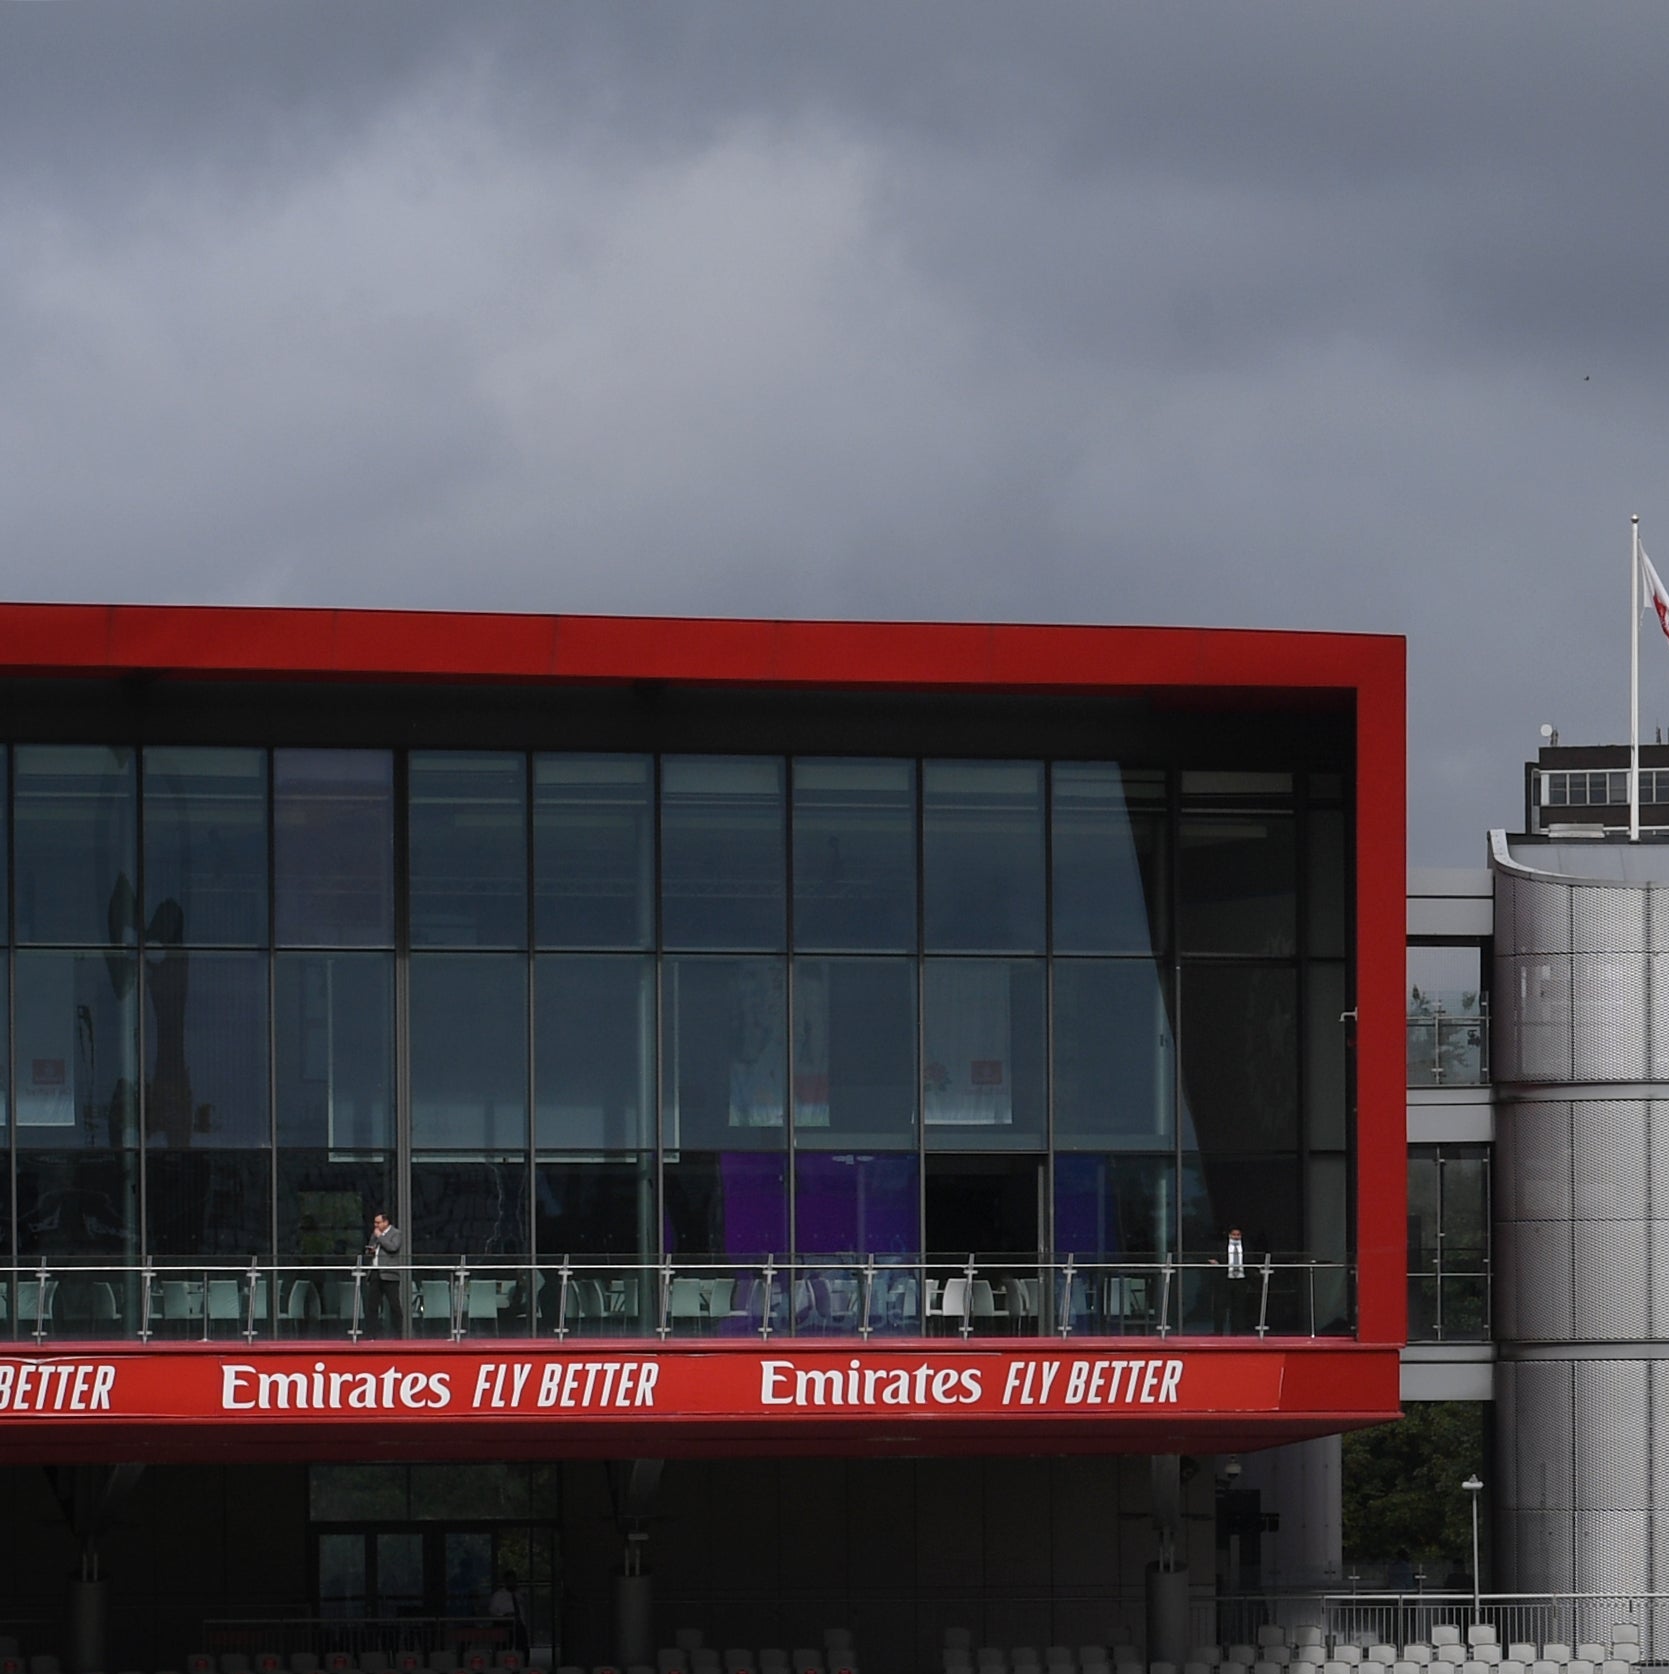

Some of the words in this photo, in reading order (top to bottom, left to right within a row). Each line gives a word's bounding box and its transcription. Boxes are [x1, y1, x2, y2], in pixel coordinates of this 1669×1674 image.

[220, 1361, 451, 1409] Emirates
[472, 1363, 533, 1408] FLY
[537, 1362, 659, 1407] BETTER
[759, 1359, 982, 1406] Emirates
[1001, 1361, 1060, 1405] FLY
[1064, 1360, 1184, 1404] BETTER
